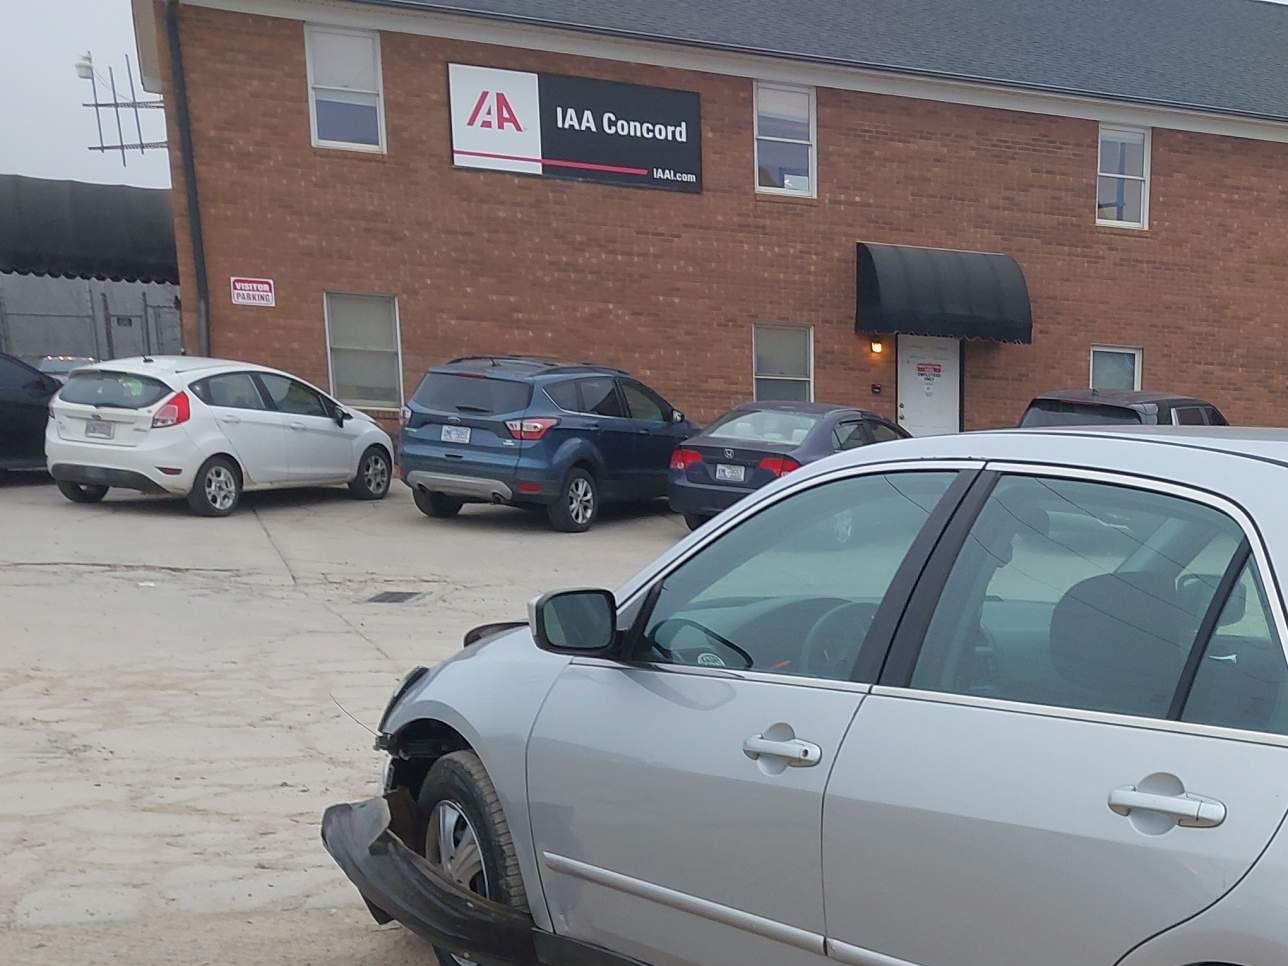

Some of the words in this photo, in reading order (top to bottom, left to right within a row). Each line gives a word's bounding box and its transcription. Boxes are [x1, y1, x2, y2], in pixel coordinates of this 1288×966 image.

[556, 106, 597, 133] IAA
[602, 112, 687, 143] Concord
[652, 167, 697, 183] IAAI.com
[234, 281, 270, 291] VISITOR
[235, 291, 271, 302] PARKING
